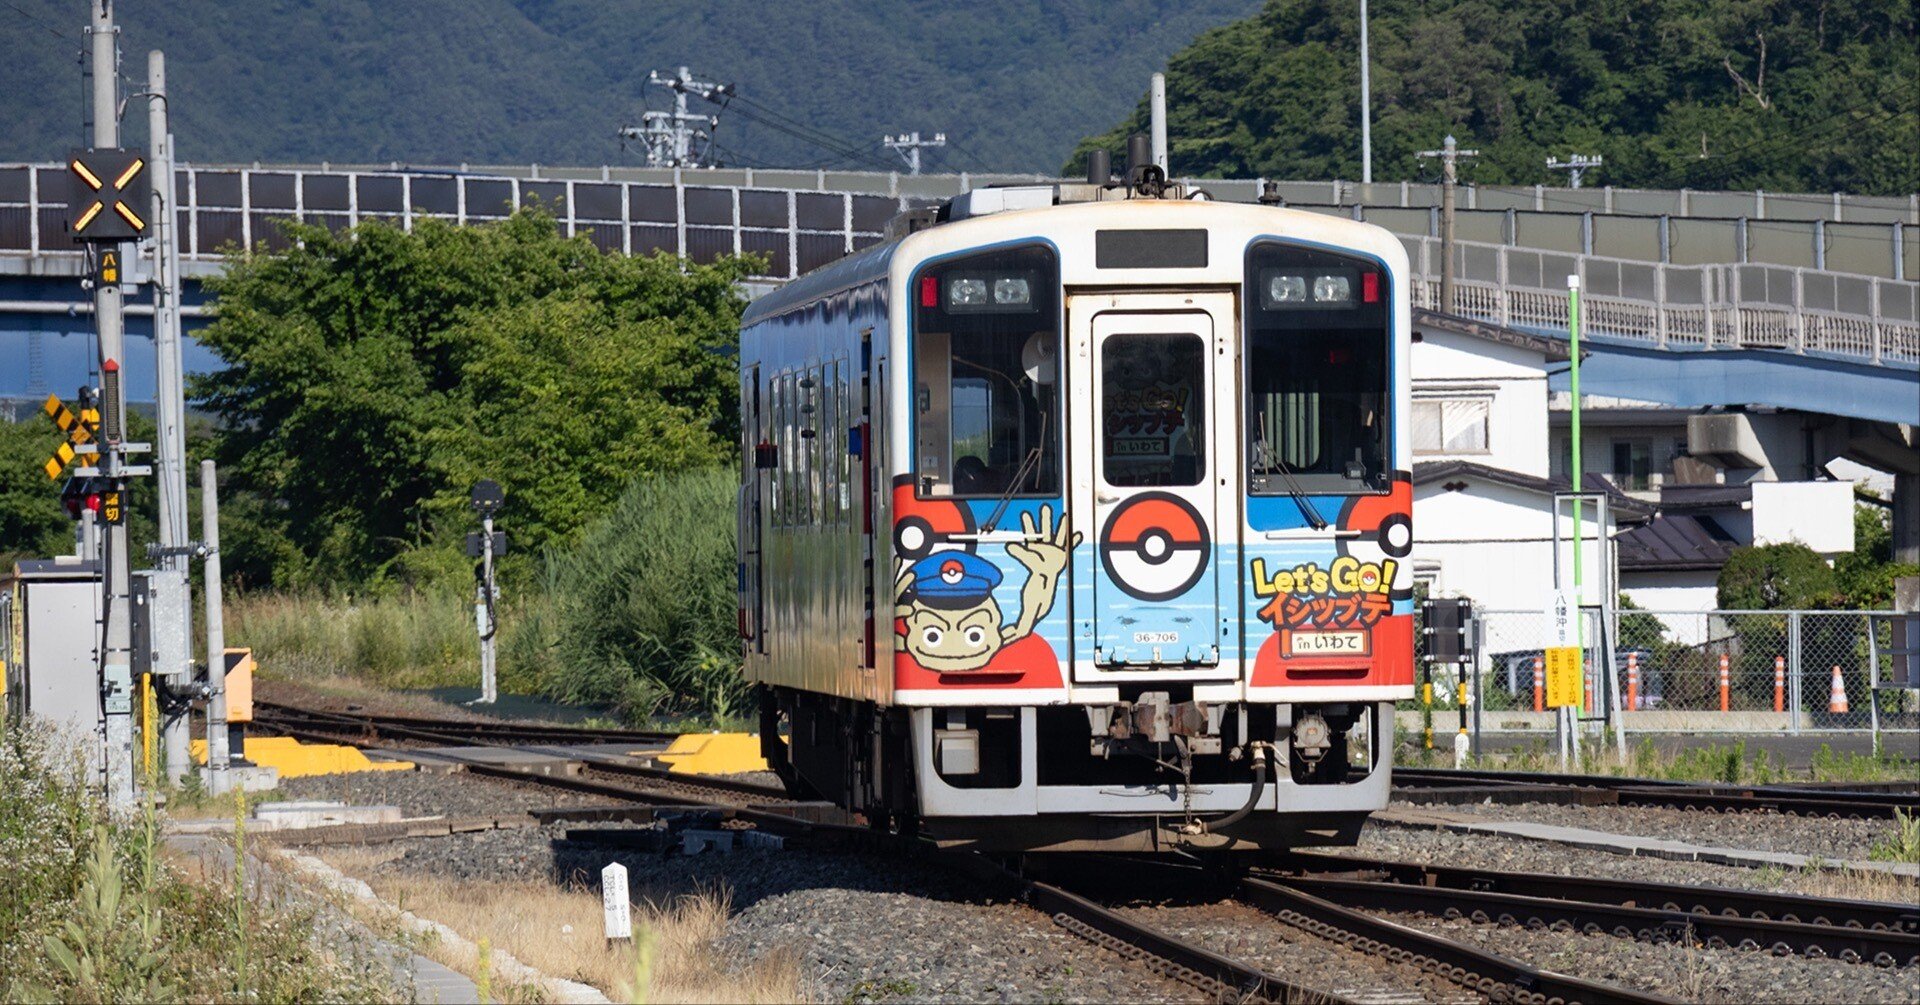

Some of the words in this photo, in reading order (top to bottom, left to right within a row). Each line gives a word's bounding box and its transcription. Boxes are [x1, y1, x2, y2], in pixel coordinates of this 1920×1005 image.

[1129, 441, 1161, 452] いわて
[1251, 557, 1330, 596] Let's
[1330, 555, 1397, 596] Go!
[1258, 591, 1392, 627] イシツブテ
[1135, 633, 1177, 643] 36-706
[1297, 637, 1311, 650] in
[1314, 635, 1359, 650] いわて
